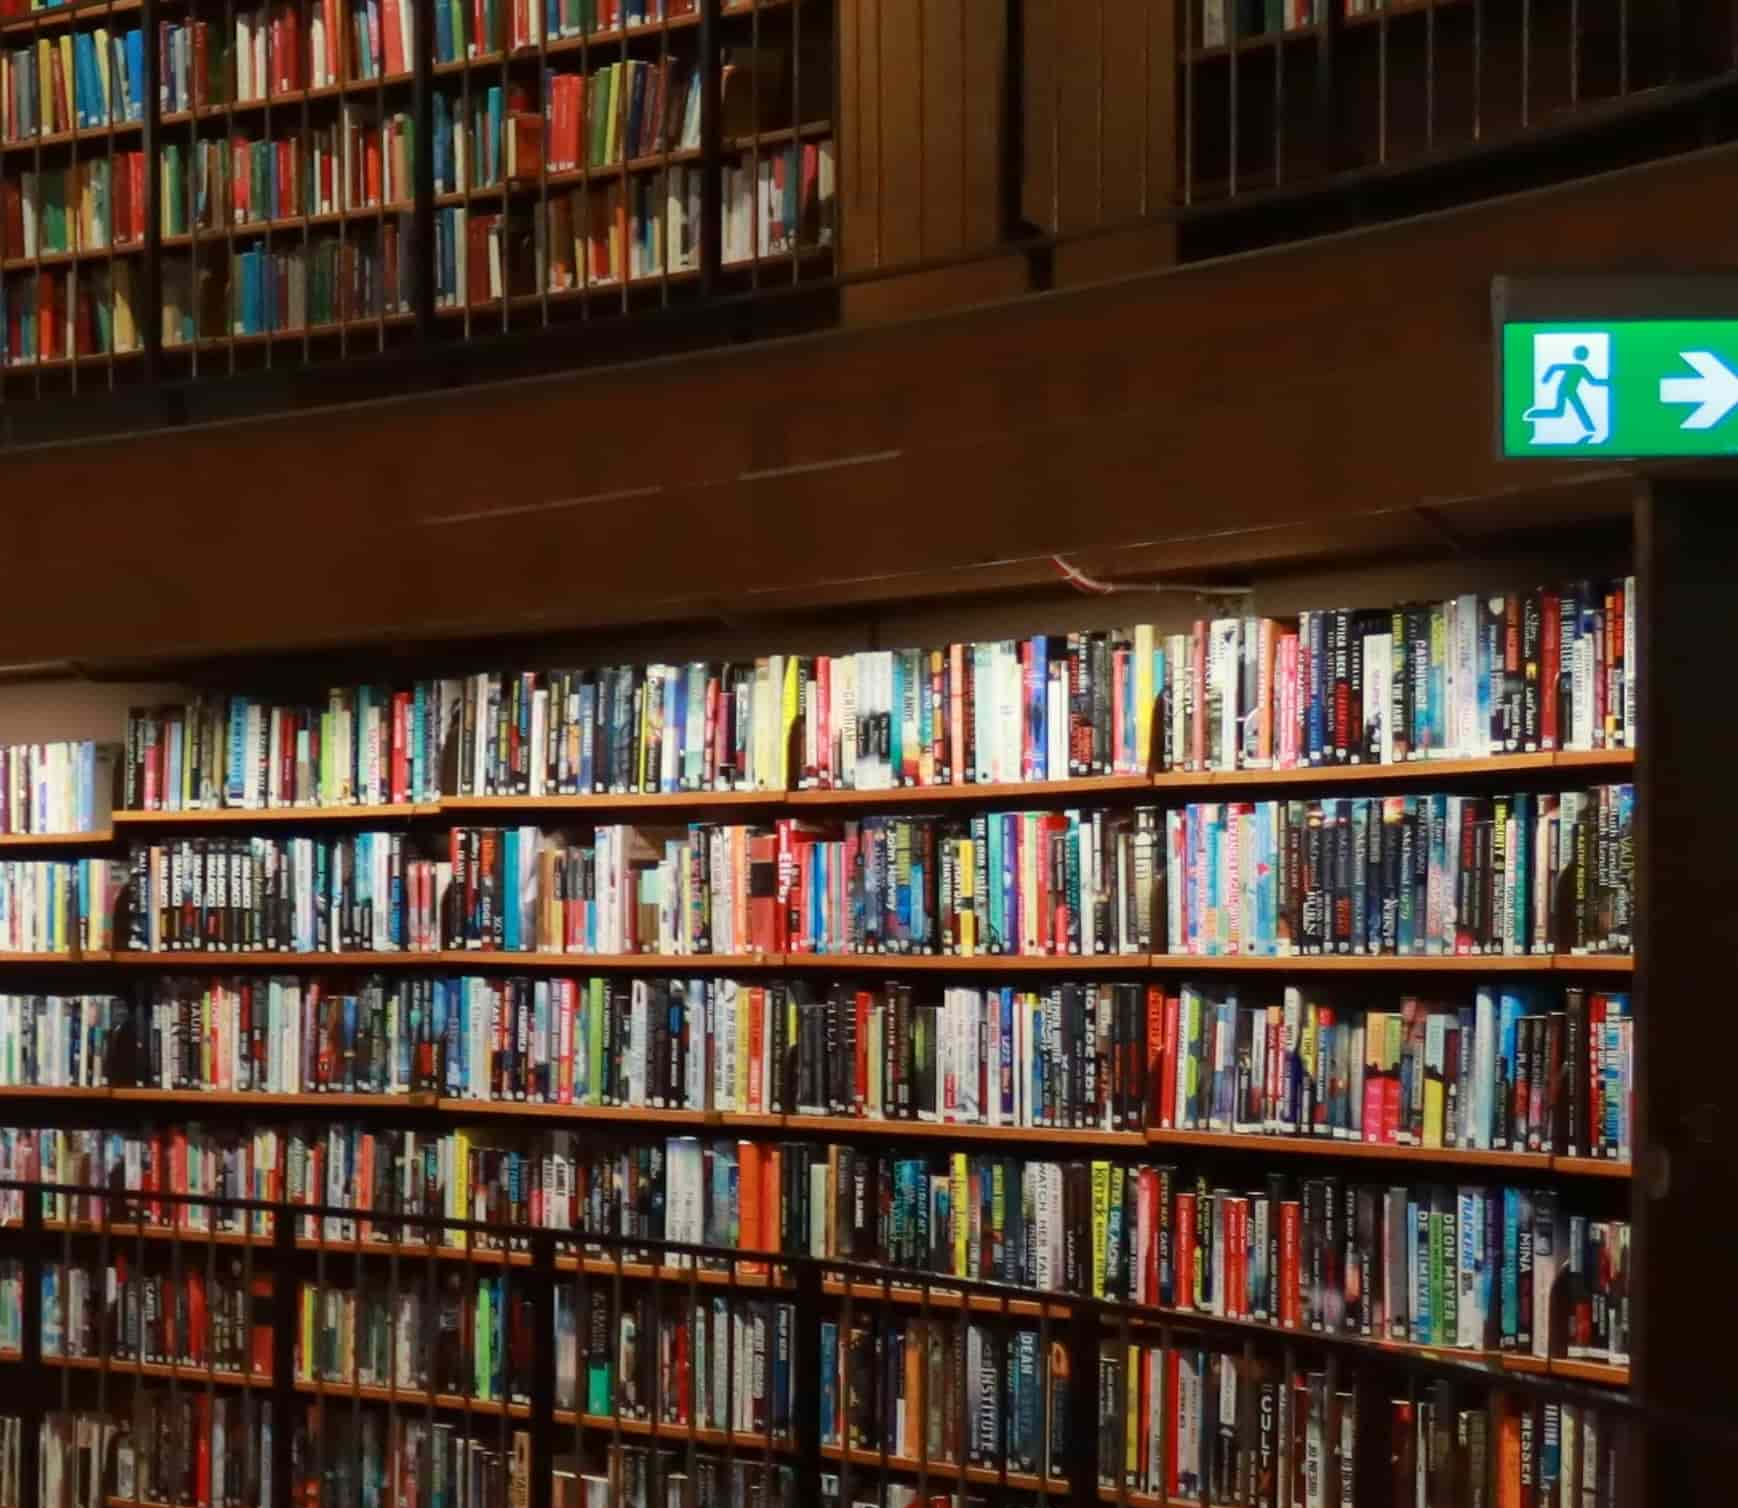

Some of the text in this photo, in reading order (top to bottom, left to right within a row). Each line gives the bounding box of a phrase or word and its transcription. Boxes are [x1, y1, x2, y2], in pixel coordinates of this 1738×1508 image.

[885, 829, 897, 911] John Harvey
[1038, 1164, 1048, 1289] WATCH HER FALL
[1444, 1266, 1455, 1320] MEYER
[1021, 1335, 1033, 1374] DEAN
